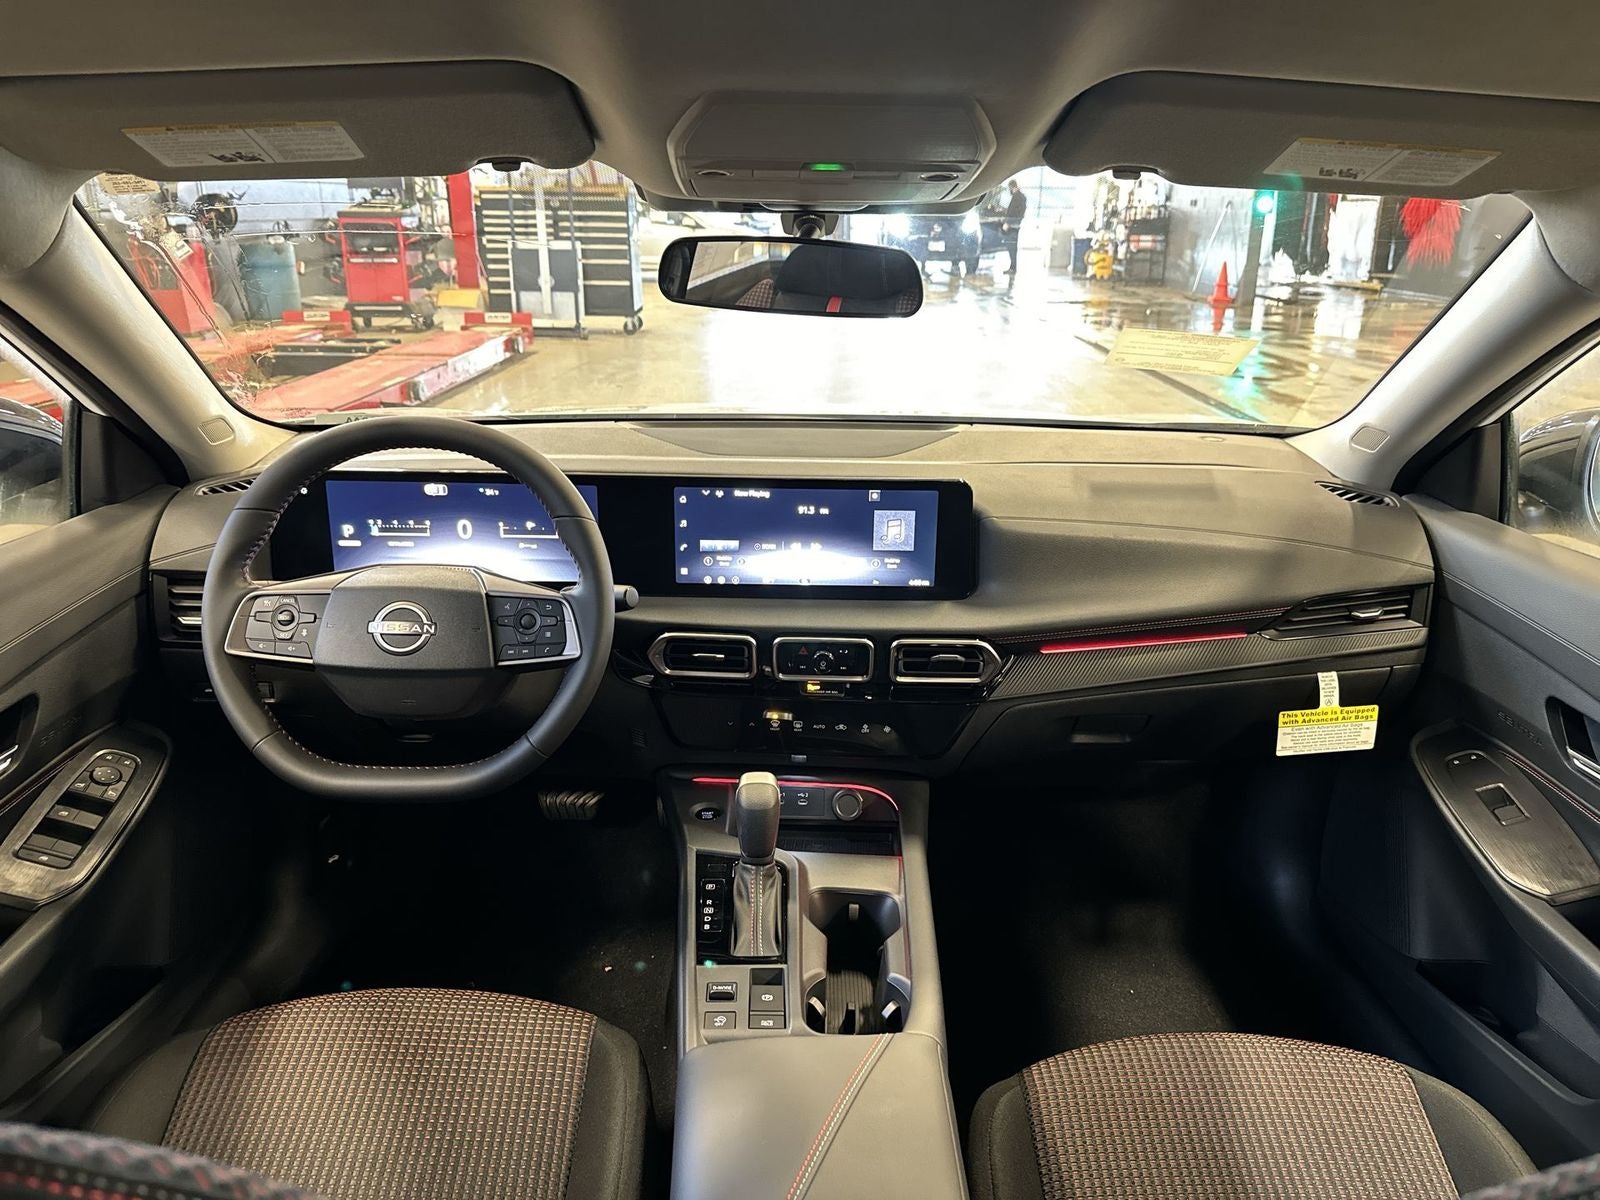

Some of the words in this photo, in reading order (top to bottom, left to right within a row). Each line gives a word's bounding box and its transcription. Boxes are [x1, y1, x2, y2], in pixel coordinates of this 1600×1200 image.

[342, 524, 355, 538] P
[456, 519, 473, 540] 0
[370, 622, 435, 633] NISSAN
[1340, 707, 1376, 715] Equipped
